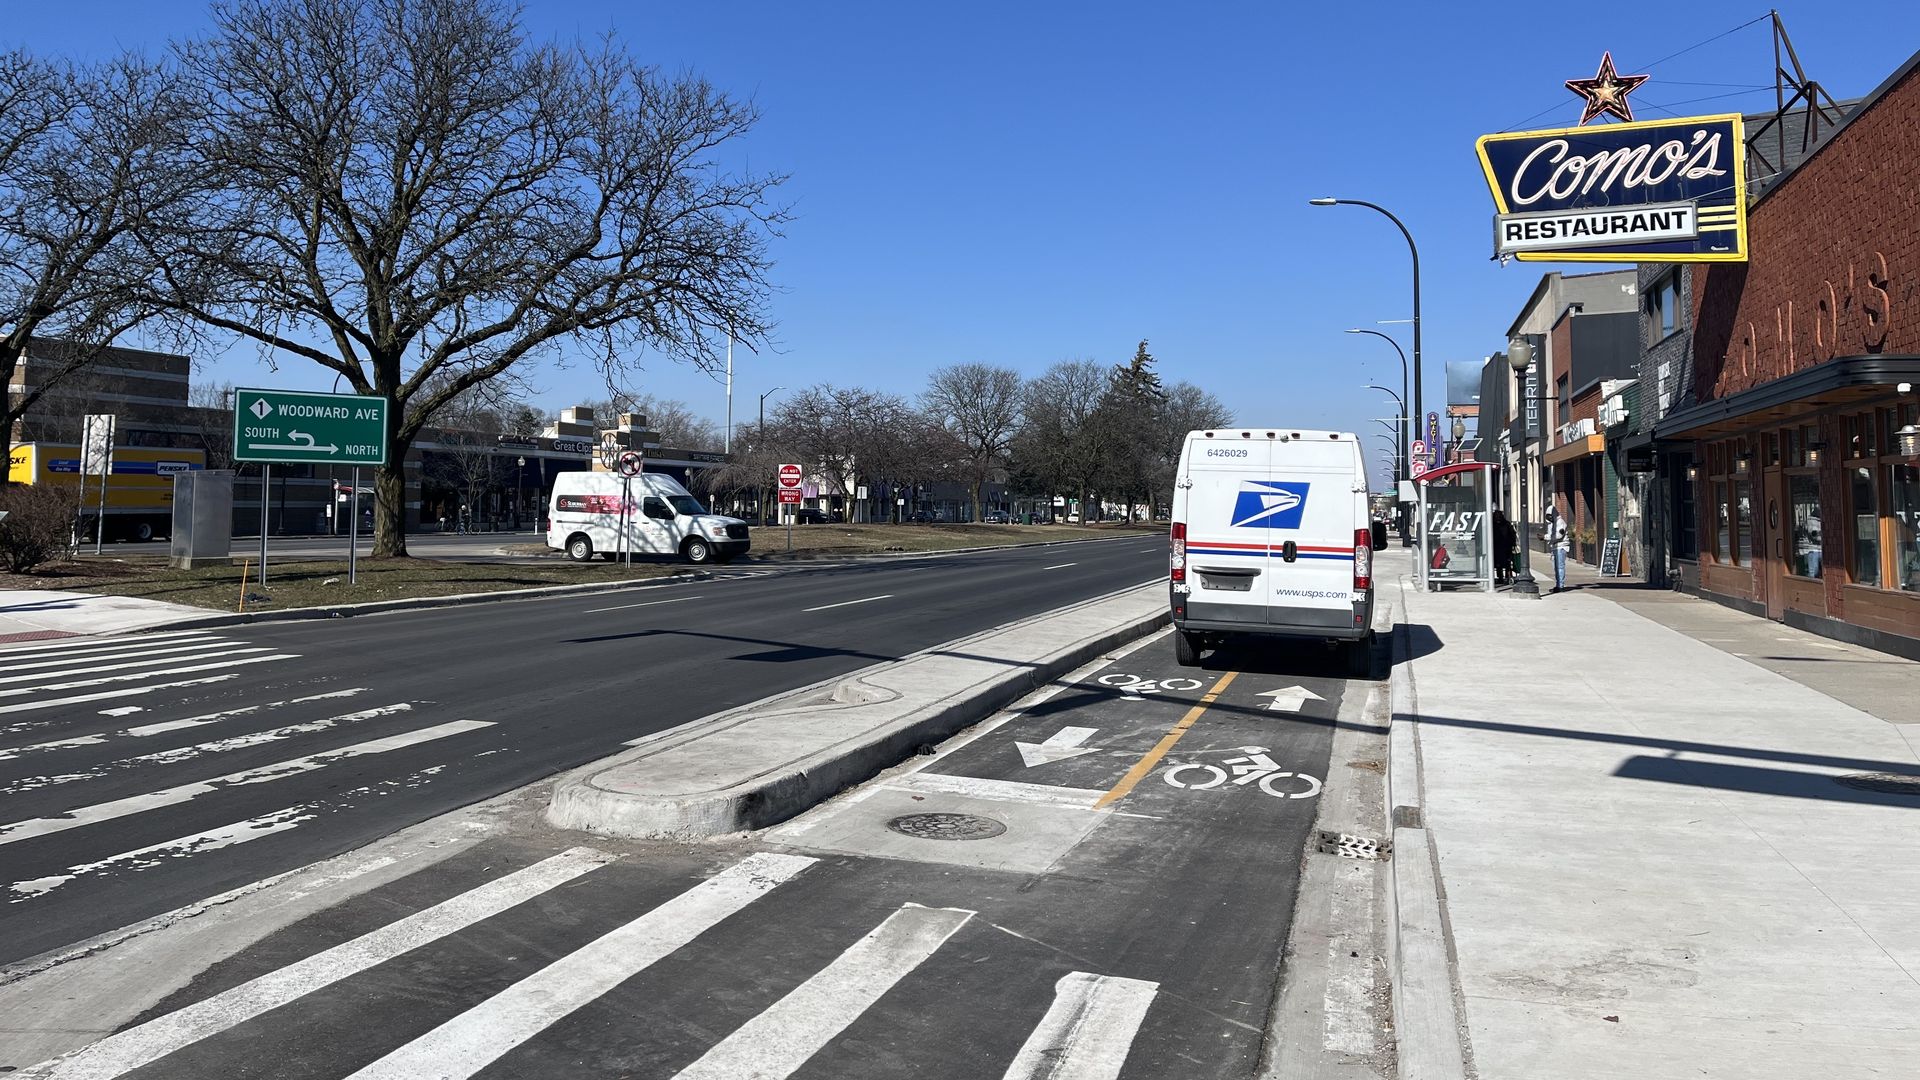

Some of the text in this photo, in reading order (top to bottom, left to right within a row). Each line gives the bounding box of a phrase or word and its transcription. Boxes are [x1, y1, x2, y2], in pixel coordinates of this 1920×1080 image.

[1511, 130, 1727, 205] Como's
[1506, 211, 1687, 241] RESTAURANT
[257, 401, 379, 420] 1 WOODWARD AVE
[244, 427, 279, 438] SOUTH
[345, 445, 378, 455] NORTH
[554, 440, 575, 452] Great
[1207, 449, 1248, 458] 6426029
[1429, 511, 1486, 531] FAST
[1276, 588, 1347, 599] www.usps.com
